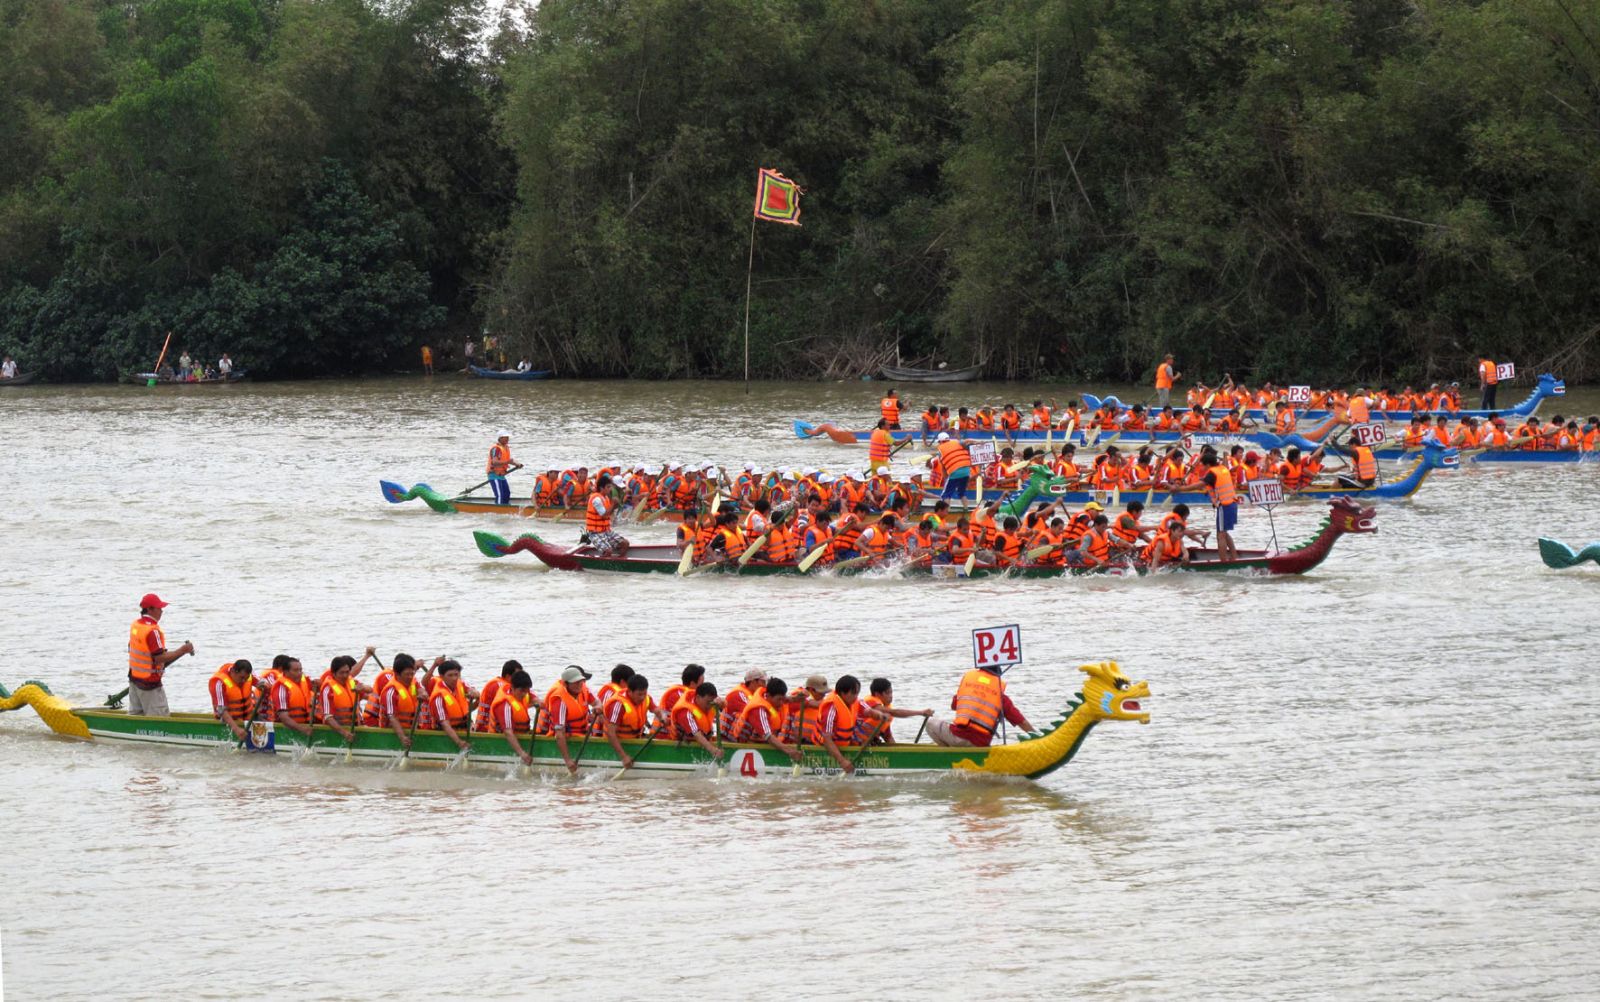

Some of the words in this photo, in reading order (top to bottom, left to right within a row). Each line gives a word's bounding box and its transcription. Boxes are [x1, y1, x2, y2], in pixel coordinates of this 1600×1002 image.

[1498, 365, 1514, 378] P.1
[1290, 387, 1310, 401] P.8
[1359, 425, 1384, 444] P.6
[1251, 484, 1262, 502] AN
[975, 629, 1018, 664] P.4
[740, 752, 758, 777] 4
